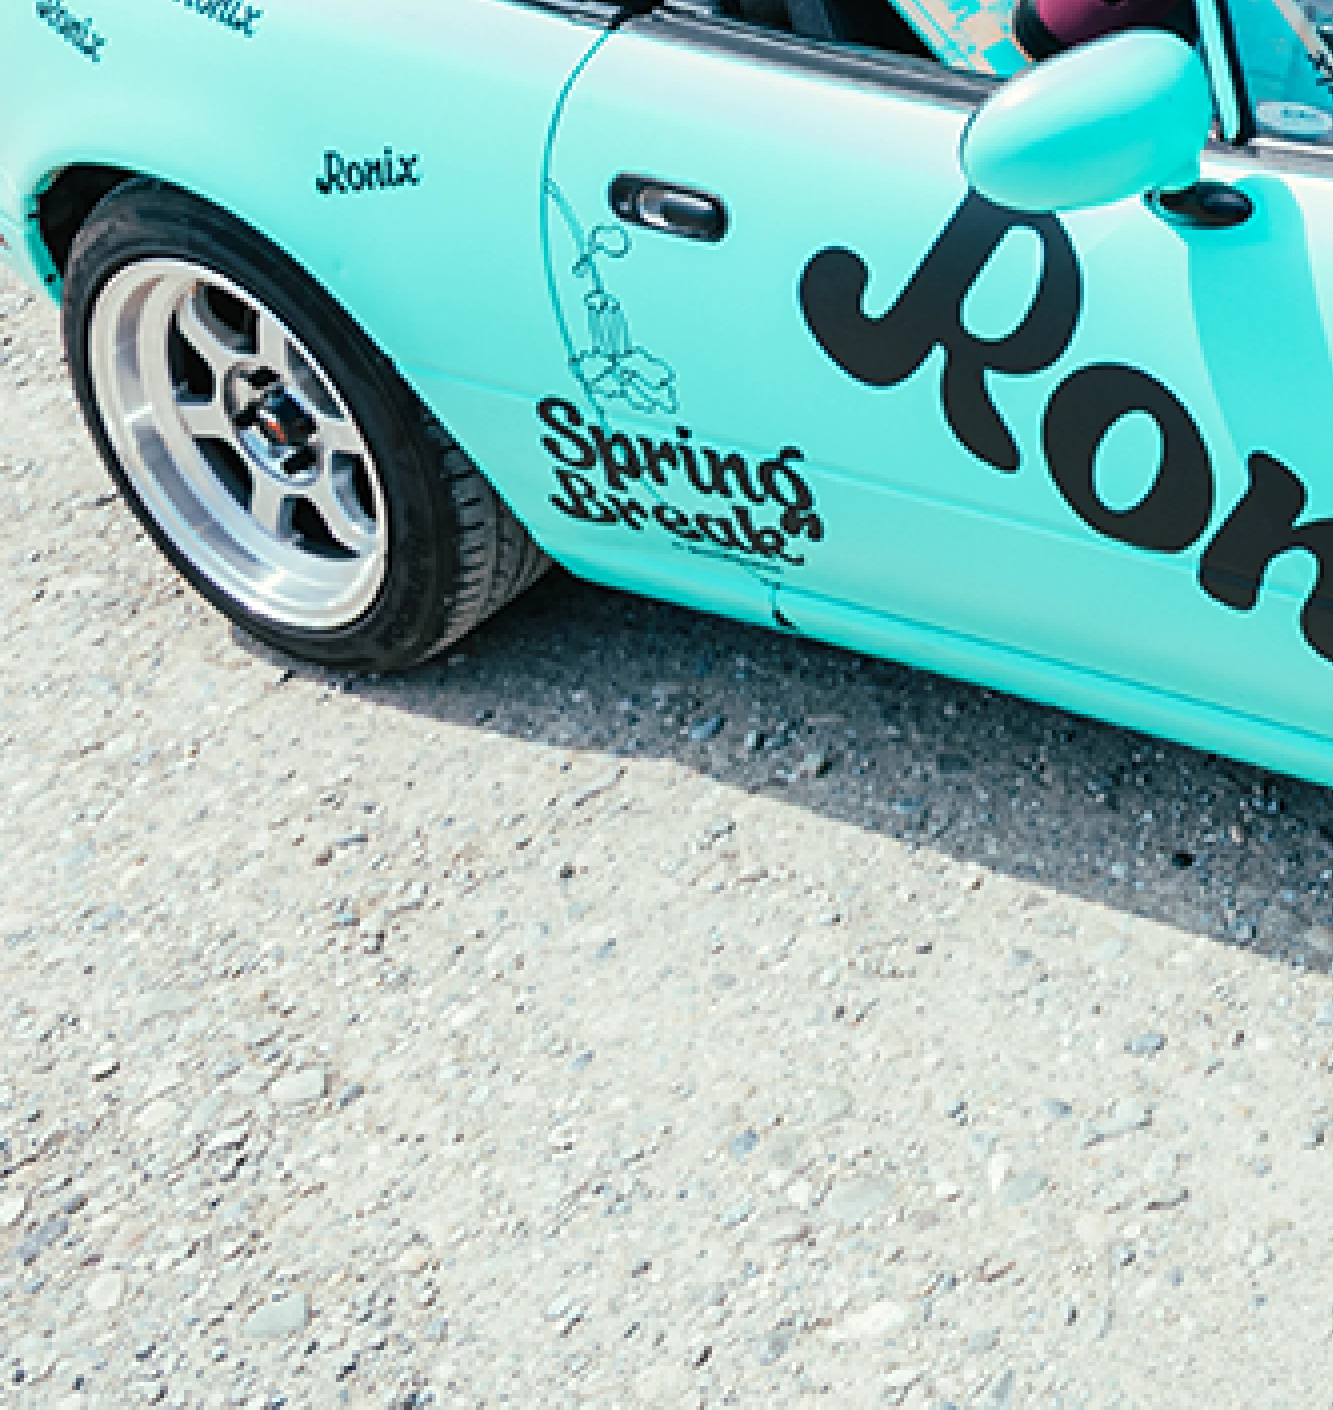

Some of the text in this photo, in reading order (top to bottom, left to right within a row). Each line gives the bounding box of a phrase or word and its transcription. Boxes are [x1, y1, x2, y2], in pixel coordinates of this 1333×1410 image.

[315, 145, 422, 195] Ronix
[535, 396, 824, 542] Spring
[548, 468, 805, 566] Break
